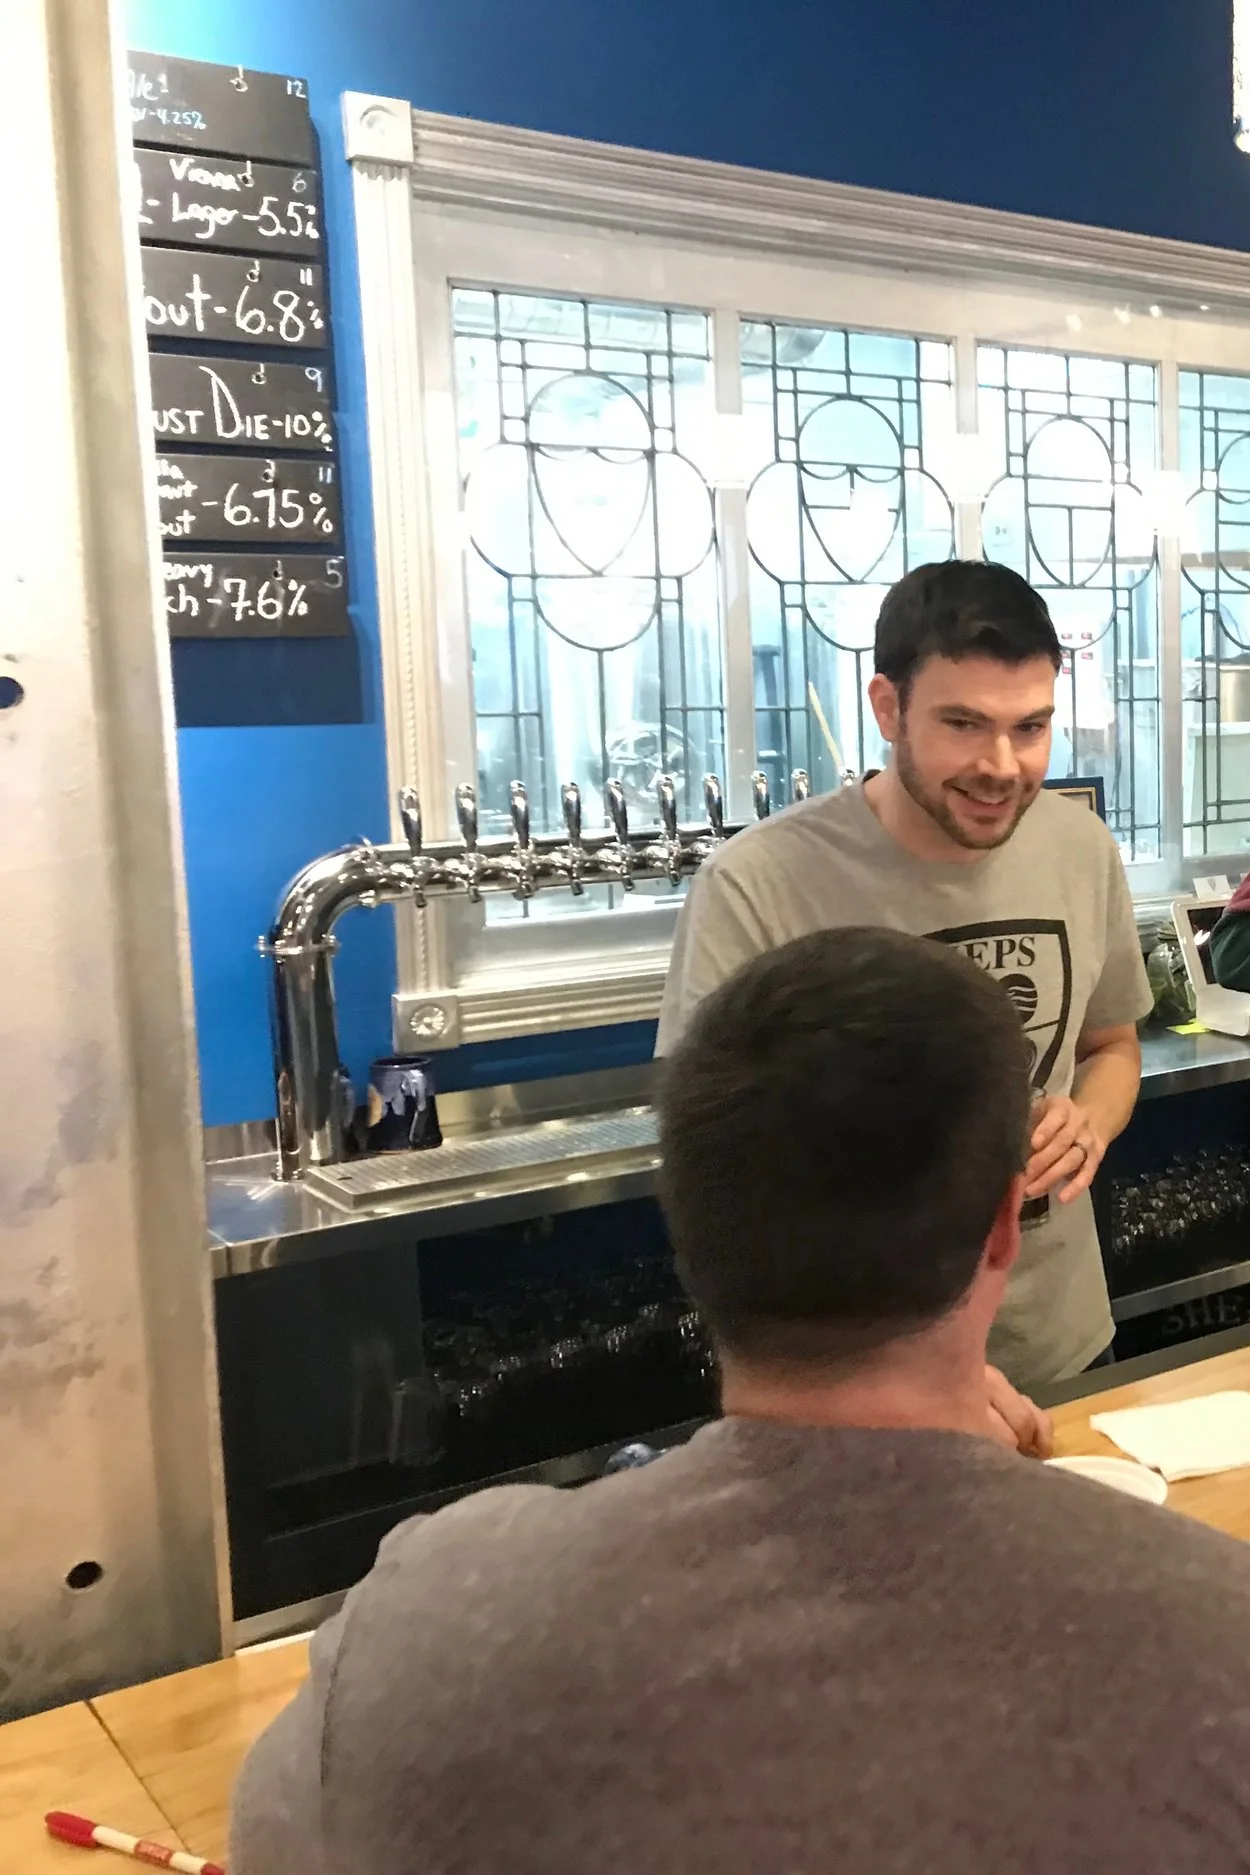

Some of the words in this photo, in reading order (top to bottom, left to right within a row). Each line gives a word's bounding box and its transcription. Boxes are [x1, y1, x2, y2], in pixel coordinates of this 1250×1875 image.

[286, 79, 306, 99] 12
[291, 172, 308, 193] 6
[304, 366, 322, 393] 9
[152, 408, 204, 434] UST
[955, 936, 1036, 970] EPS
